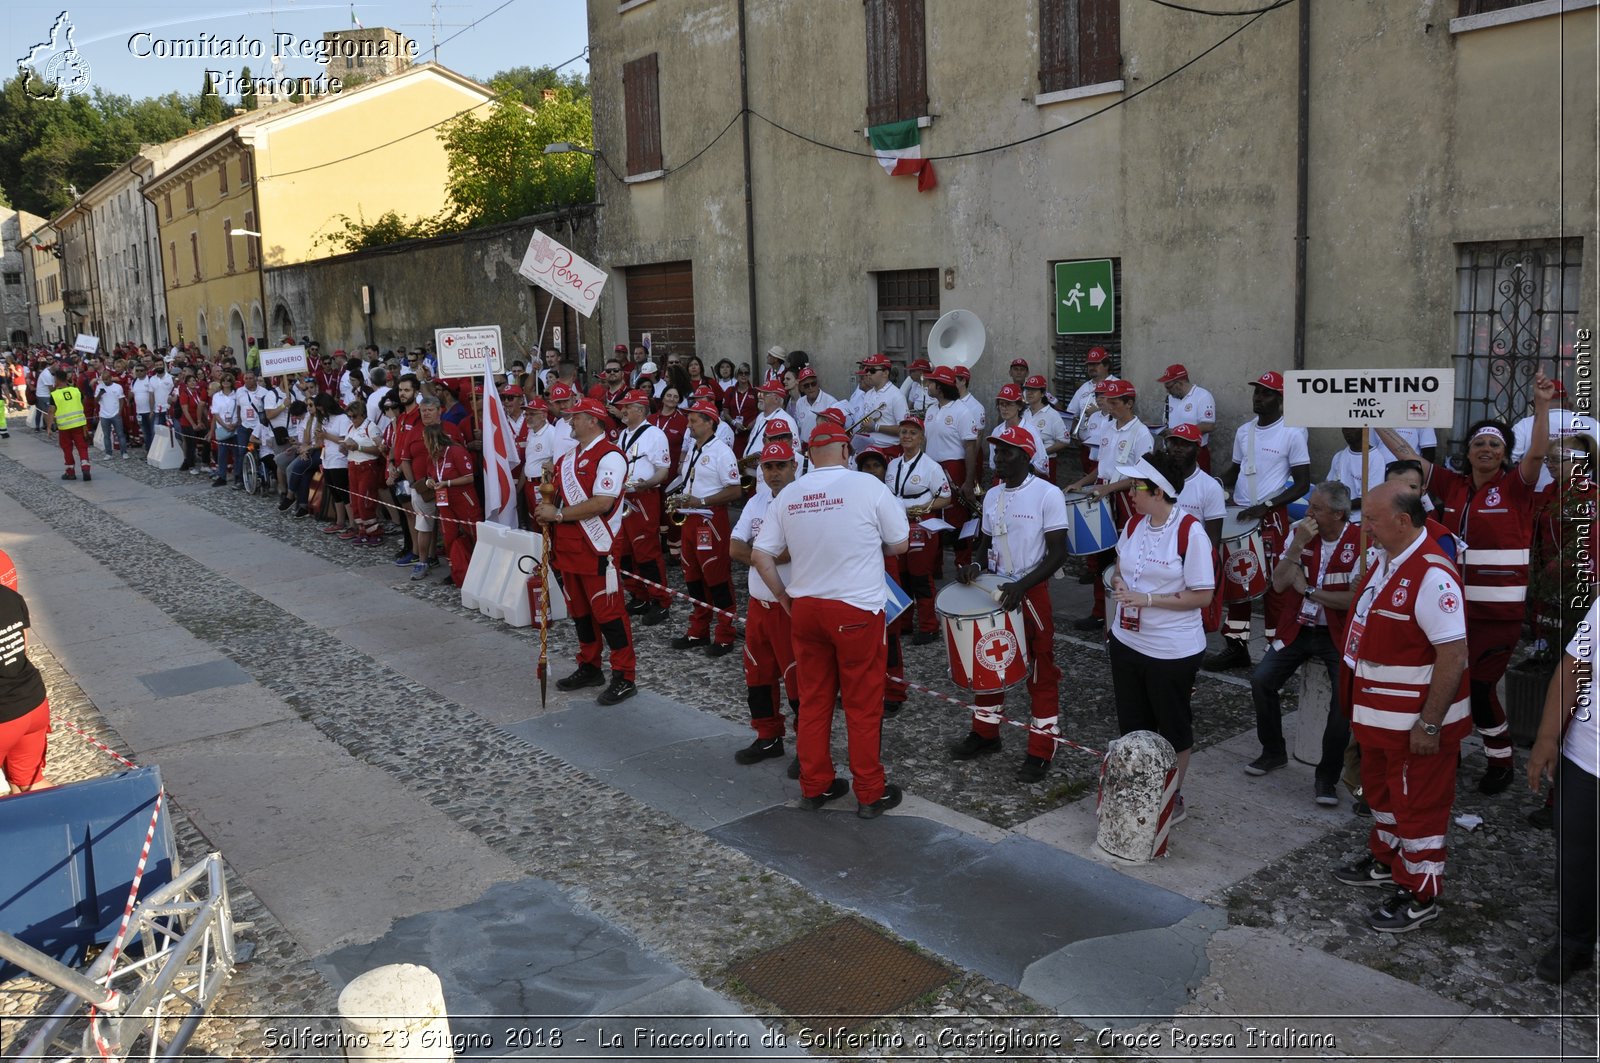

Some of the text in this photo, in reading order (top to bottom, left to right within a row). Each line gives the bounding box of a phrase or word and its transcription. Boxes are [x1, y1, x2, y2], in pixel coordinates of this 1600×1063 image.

[530, 247, 583, 291] Roma
[583, 281, 602, 300] 6
[265, 355, 303, 366] BRUGHERIO
[1297, 376, 1440, 394] TOLENTINO
[1353, 398, 1380, 407] -MC-
[1348, 409, 1385, 418] ITALY
[566, 482, 583, 504] ROSS
[803, 492, 827, 502] FANFARA
[788, 497, 844, 511] CROCE ROSSA ITALIANA
[985, 630, 1006, 641] GINEVRA
